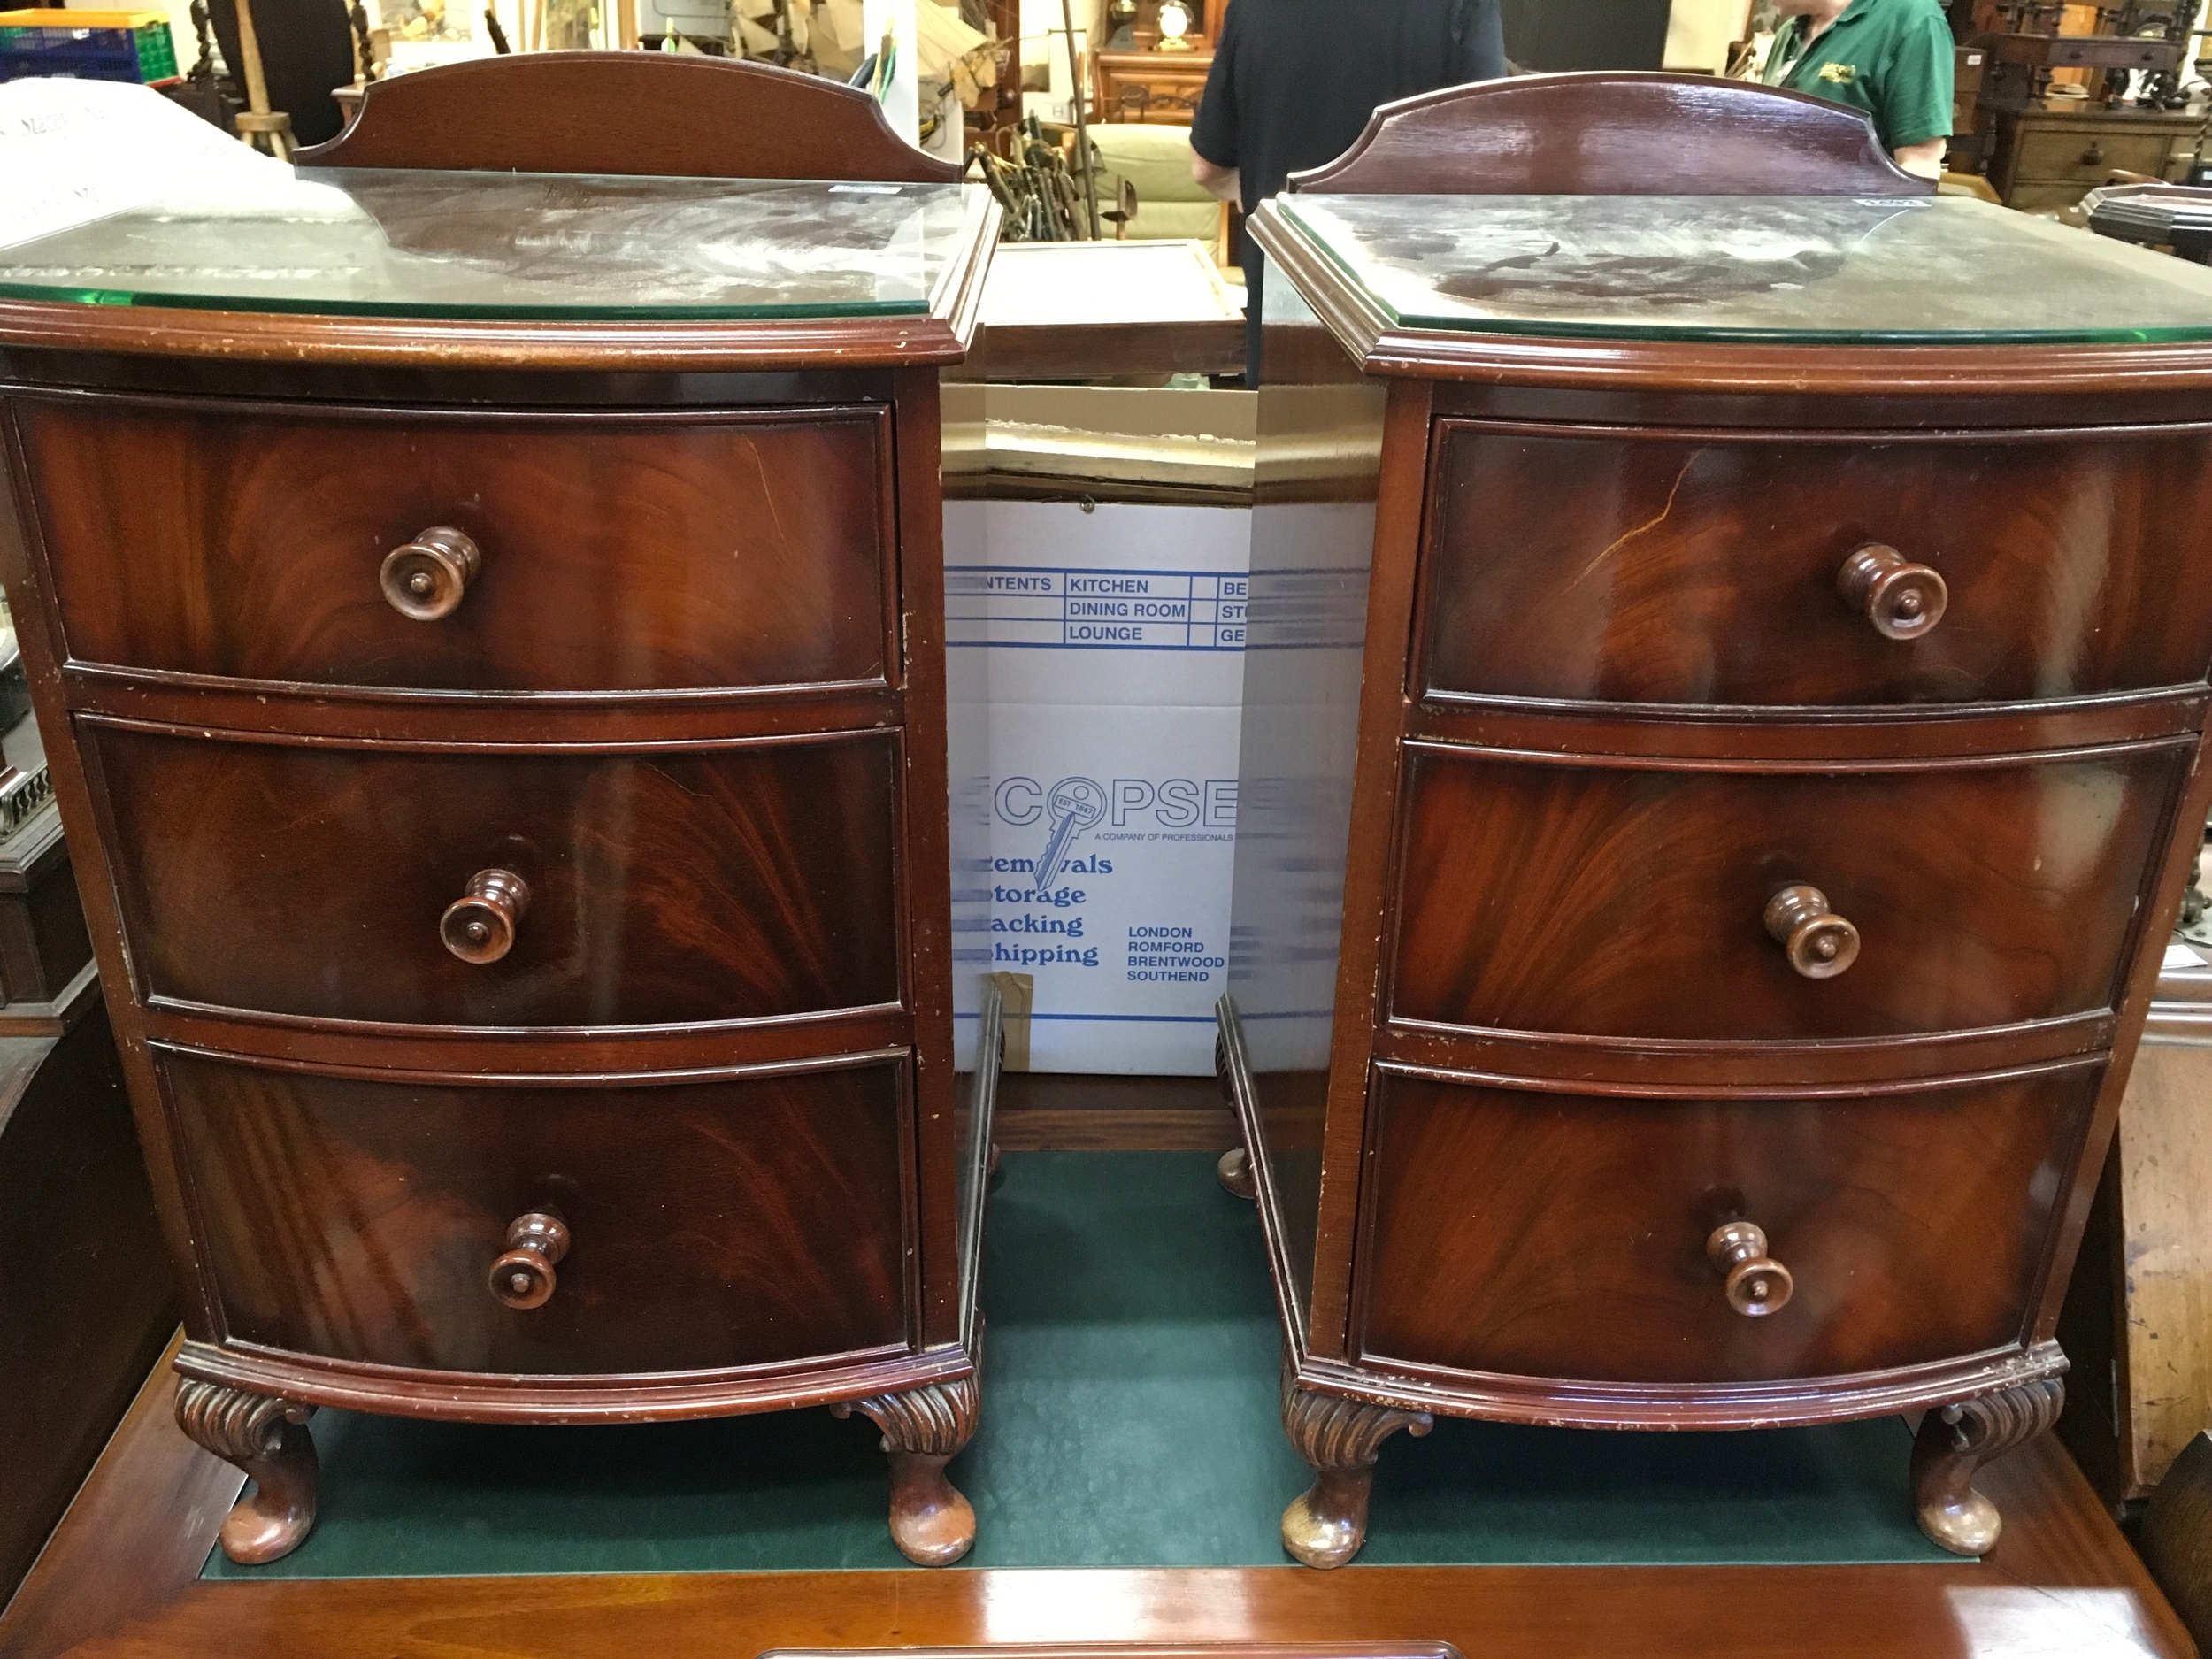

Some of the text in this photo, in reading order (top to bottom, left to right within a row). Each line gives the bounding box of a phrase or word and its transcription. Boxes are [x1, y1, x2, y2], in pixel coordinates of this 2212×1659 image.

[1070, 579, 1148, 593] KITCHEN
[1224, 581, 1247, 595] BE
[1070, 602, 1186, 618] DINING ROOM
[1069, 626, 1142, 640] LOUNGE
[1220, 629, 1245, 642] GE
[1058, 798, 1094, 815] EST 1847
[1128, 926, 1192, 938] LONDON
[1128, 941, 1204, 953] ROMFORD
[1127, 956, 1225, 968] BRENTWOOD
[1127, 970, 1209, 982] SOUTHEND
